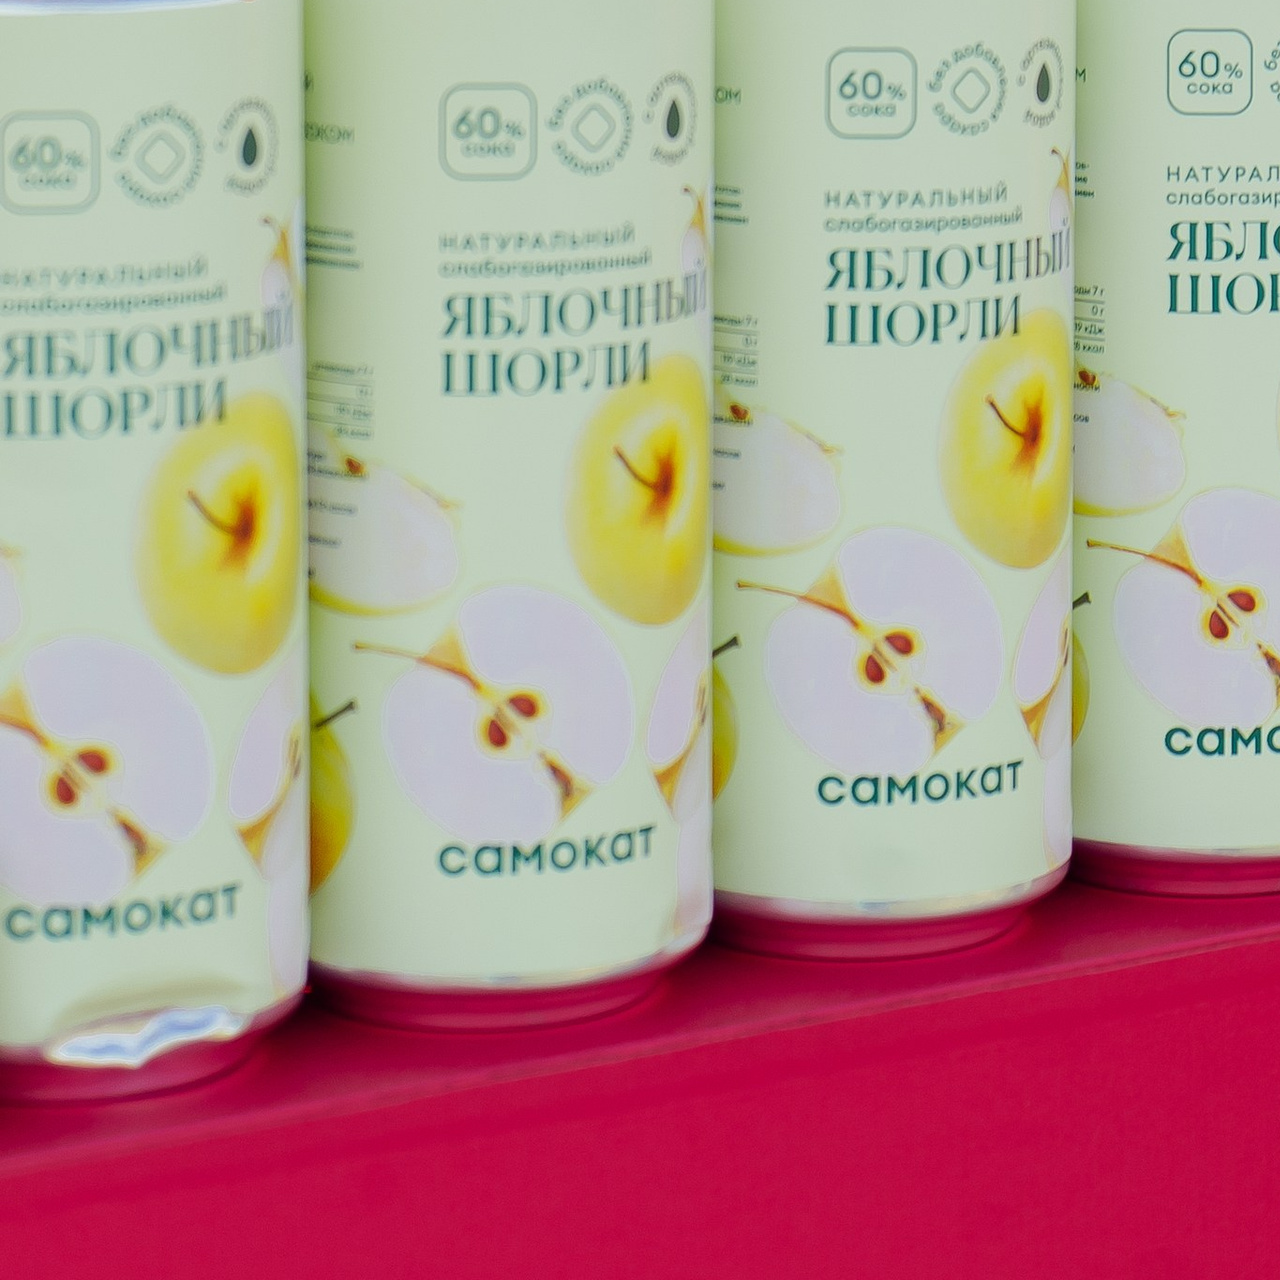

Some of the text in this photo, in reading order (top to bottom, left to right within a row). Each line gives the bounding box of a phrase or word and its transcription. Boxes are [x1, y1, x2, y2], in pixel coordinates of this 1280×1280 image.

[838, 69, 907, 100] 60%
[1178, 49, 1243, 79] 60%
[1187, 82, 1233, 95] сока
[453, 107, 525, 139] 60%
[823, 205, 1023, 235] слабогазированный
[824, 180, 1008, 209] НАТУРАЛЬНЫЙ
[439, 220, 636, 252] НАТУРАЛЬНЫЙ
[825, 217, 1071, 290] ЯБЛОЧНЫЙ
[441, 257, 708, 337] ЯБЛОЧНЫЙ
[826, 292, 1021, 347] ШОРЛИ
[2, 294, 293, 378] ЯБЛОЧНЫЙ
[441, 341, 650, 397] ШОРЛИ
[3, 380, 228, 439] ШОРЛИ
[817, 757, 1024, 806] самокат
[437, 824, 657, 877] самокат
[5, 881, 242, 941] самокат
